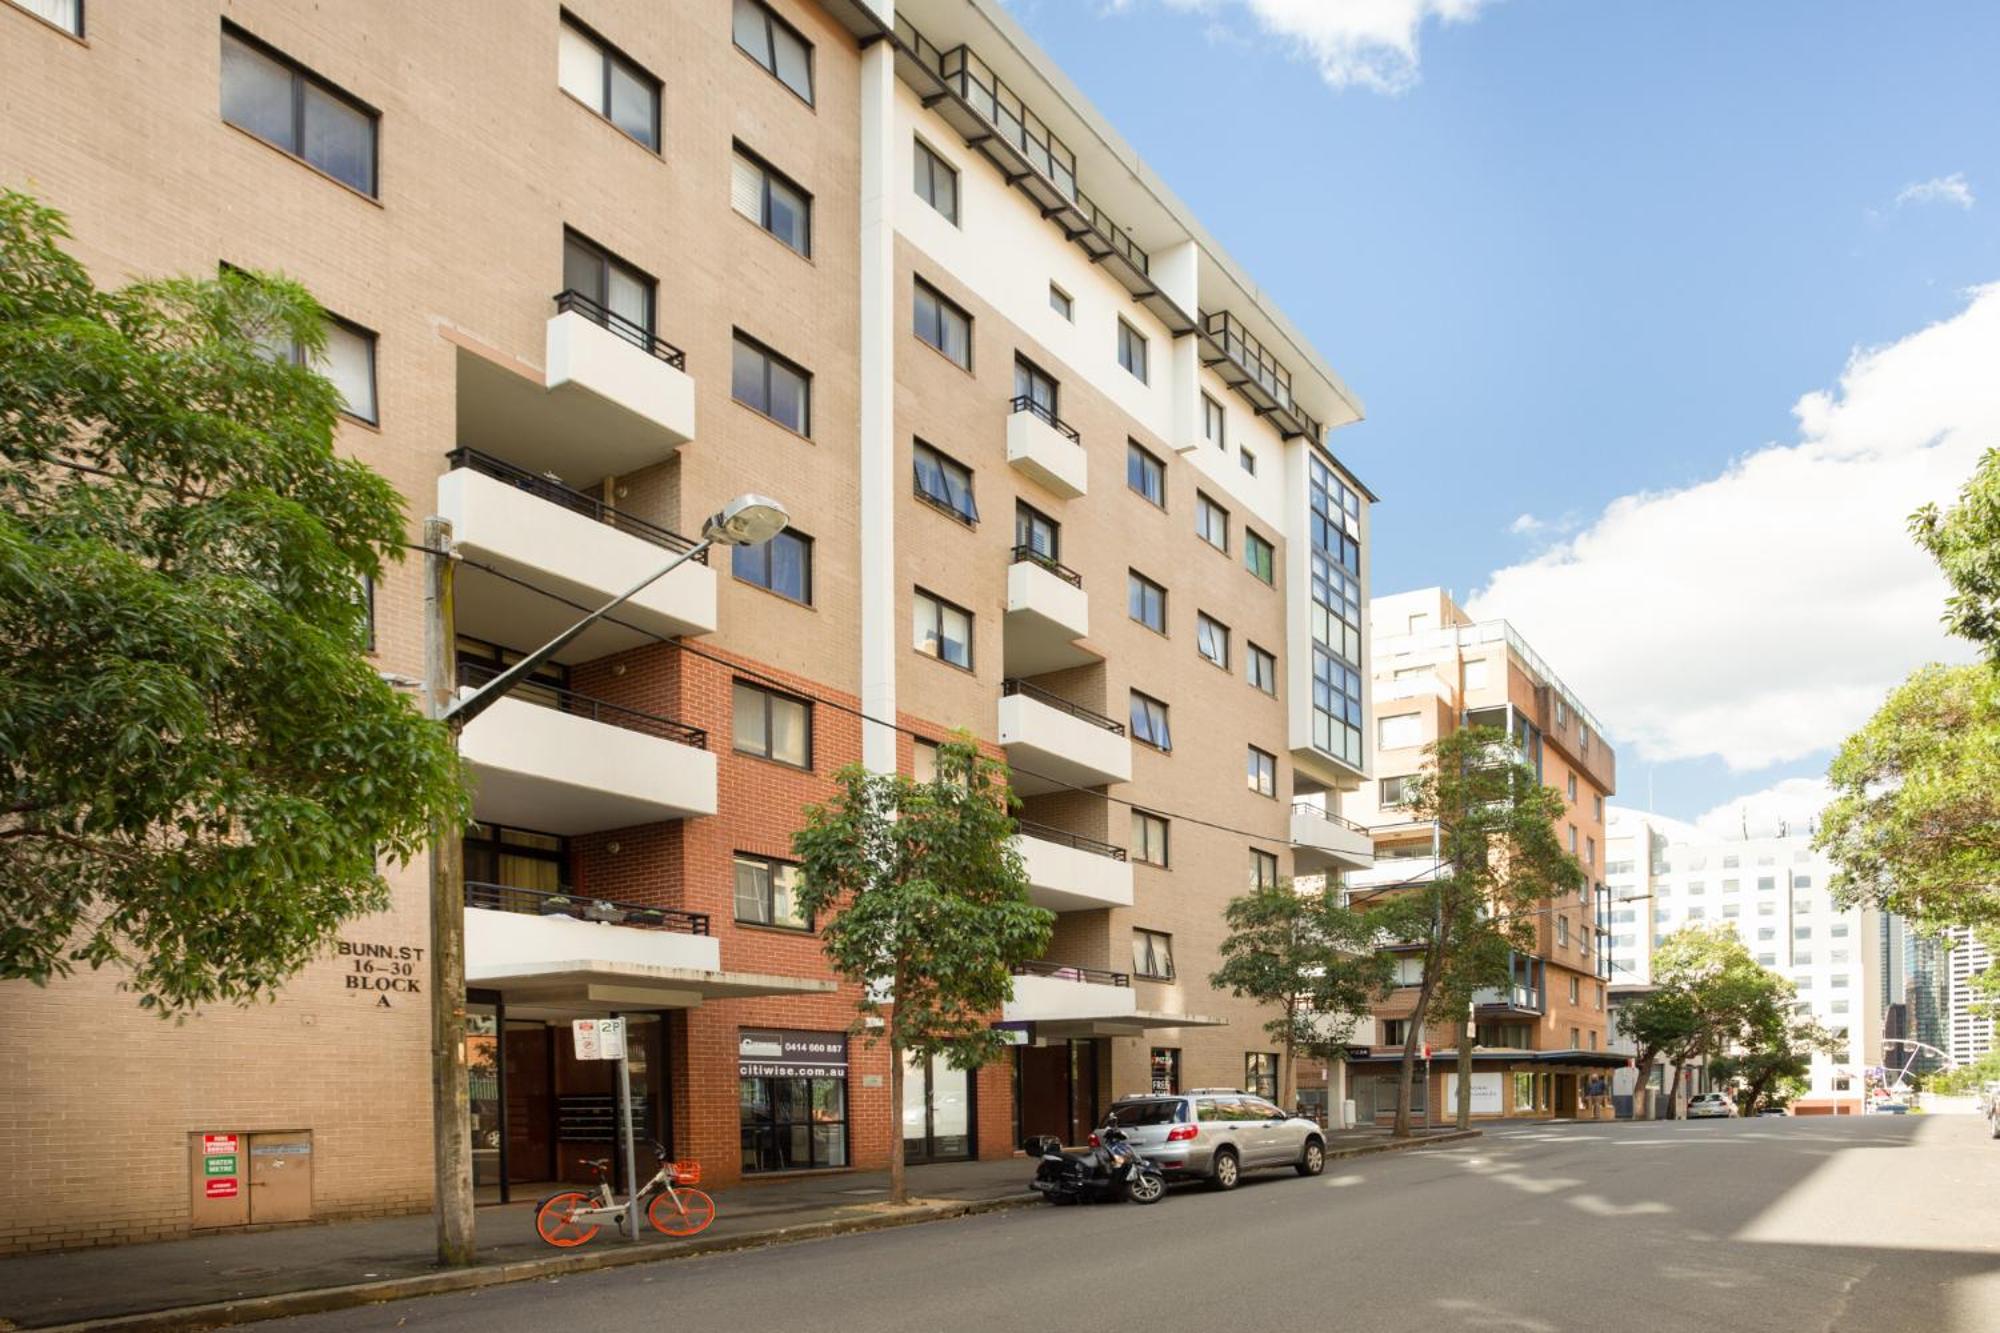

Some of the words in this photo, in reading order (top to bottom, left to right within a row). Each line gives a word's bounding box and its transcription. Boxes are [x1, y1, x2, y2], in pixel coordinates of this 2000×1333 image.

[354, 959, 412, 976] 16-30
[346, 975, 421, 993] BLOCK
[376, 994, 391, 1008] A
[601, 1022, 620, 1033] 2P
[784, 1042, 807, 1052] 0414
[740, 1065, 845, 1077] citiwise.com.au
